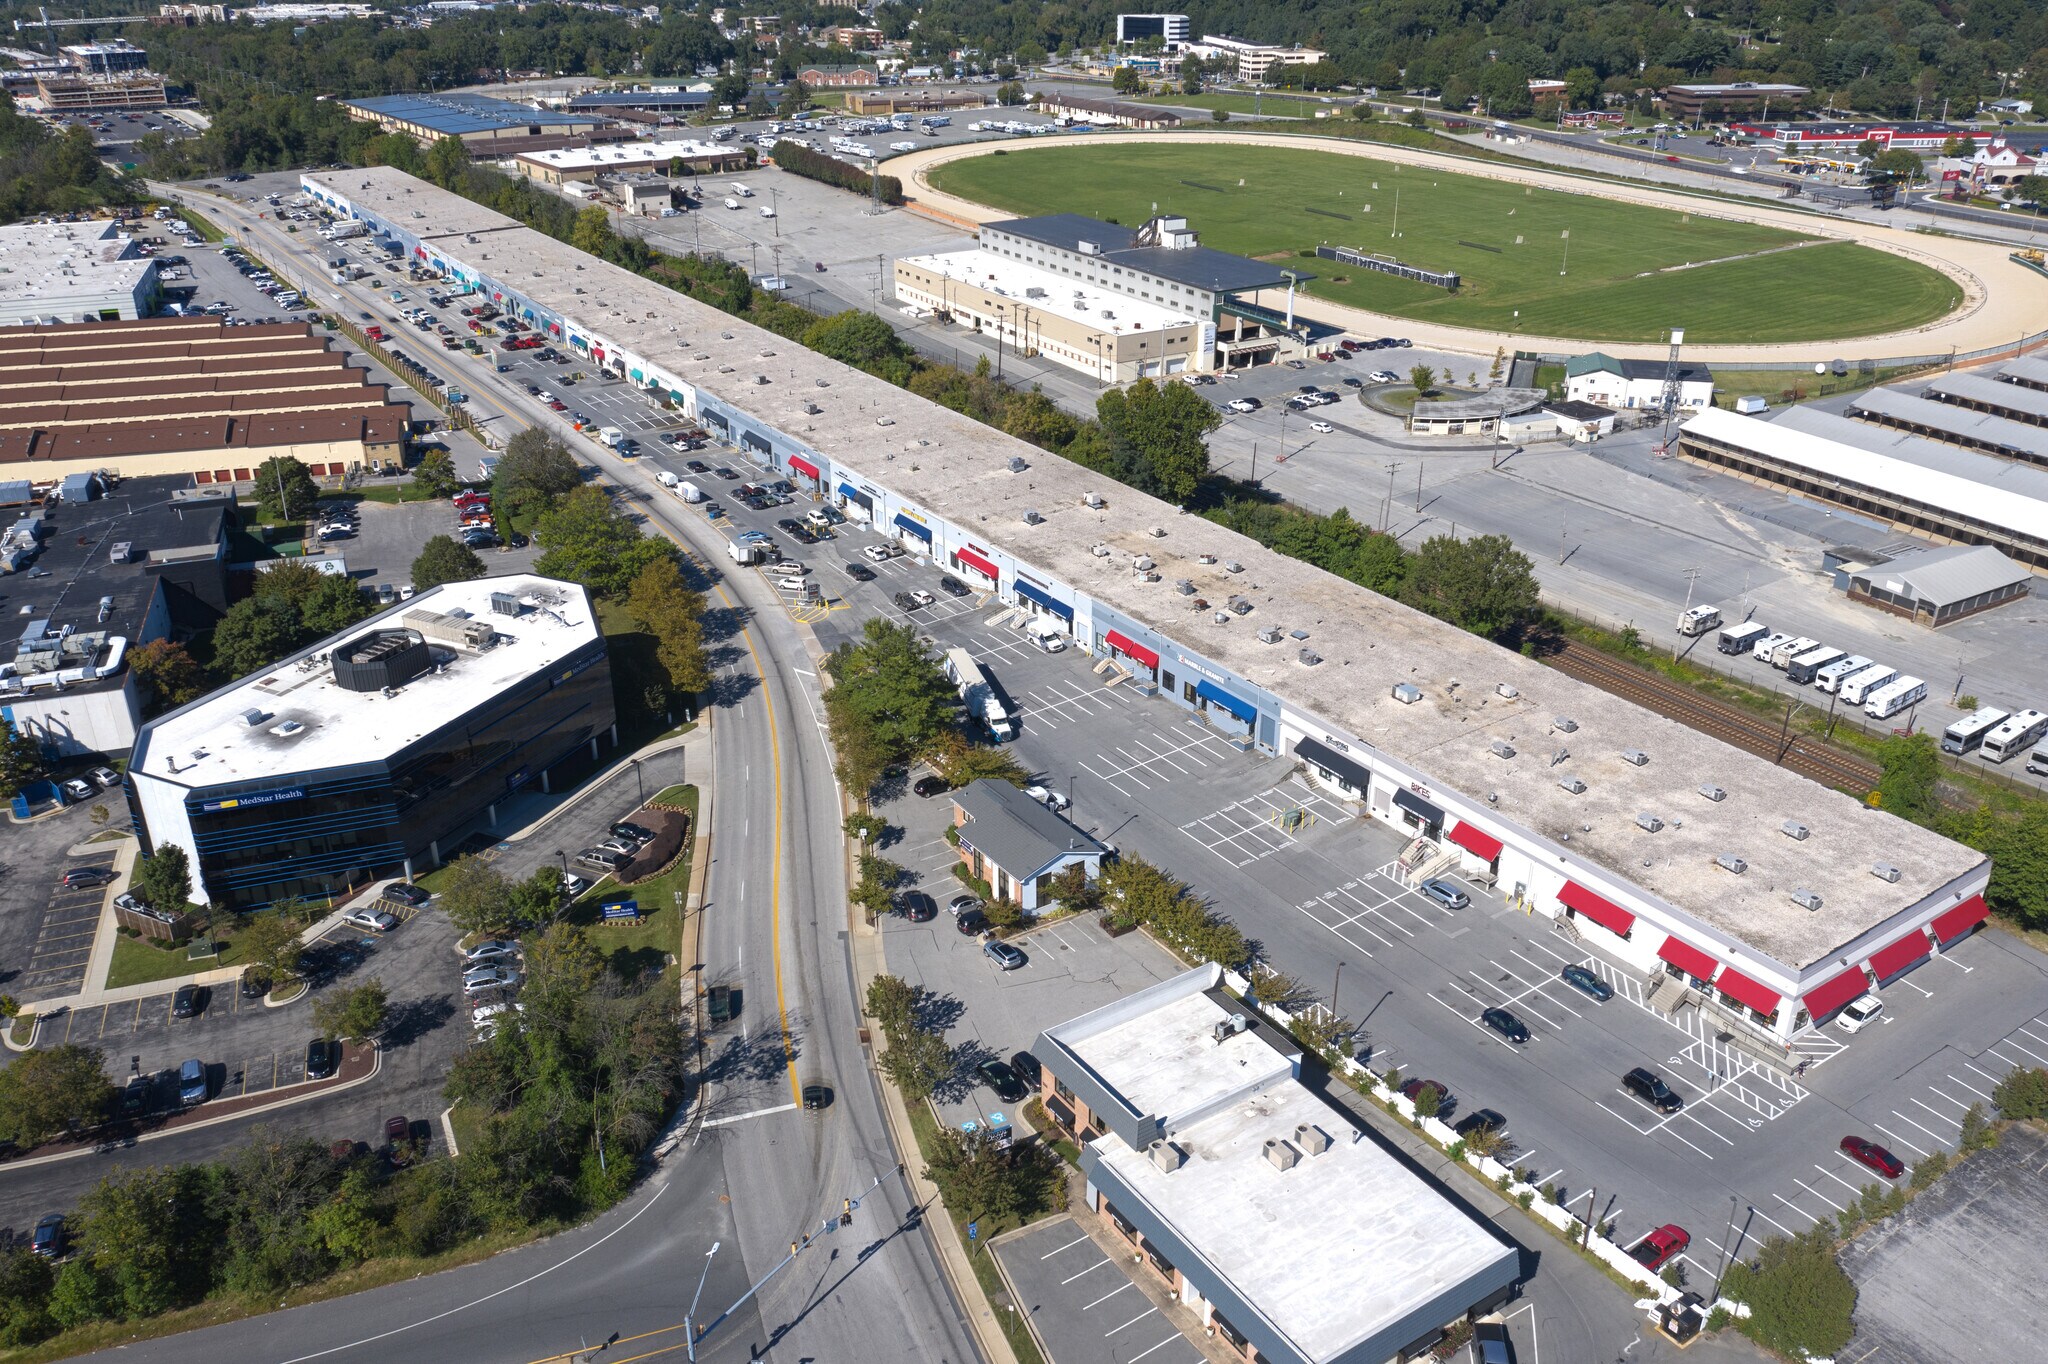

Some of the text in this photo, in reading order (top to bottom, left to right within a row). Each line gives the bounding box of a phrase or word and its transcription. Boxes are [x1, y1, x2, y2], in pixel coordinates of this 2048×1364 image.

[1184, 657, 1201, 672] MARBLE
[1205, 669, 1225, 685] GRANITE
[240, 790, 303, 806] MedStar Health
[1411, 781, 1430, 799] BIKES
